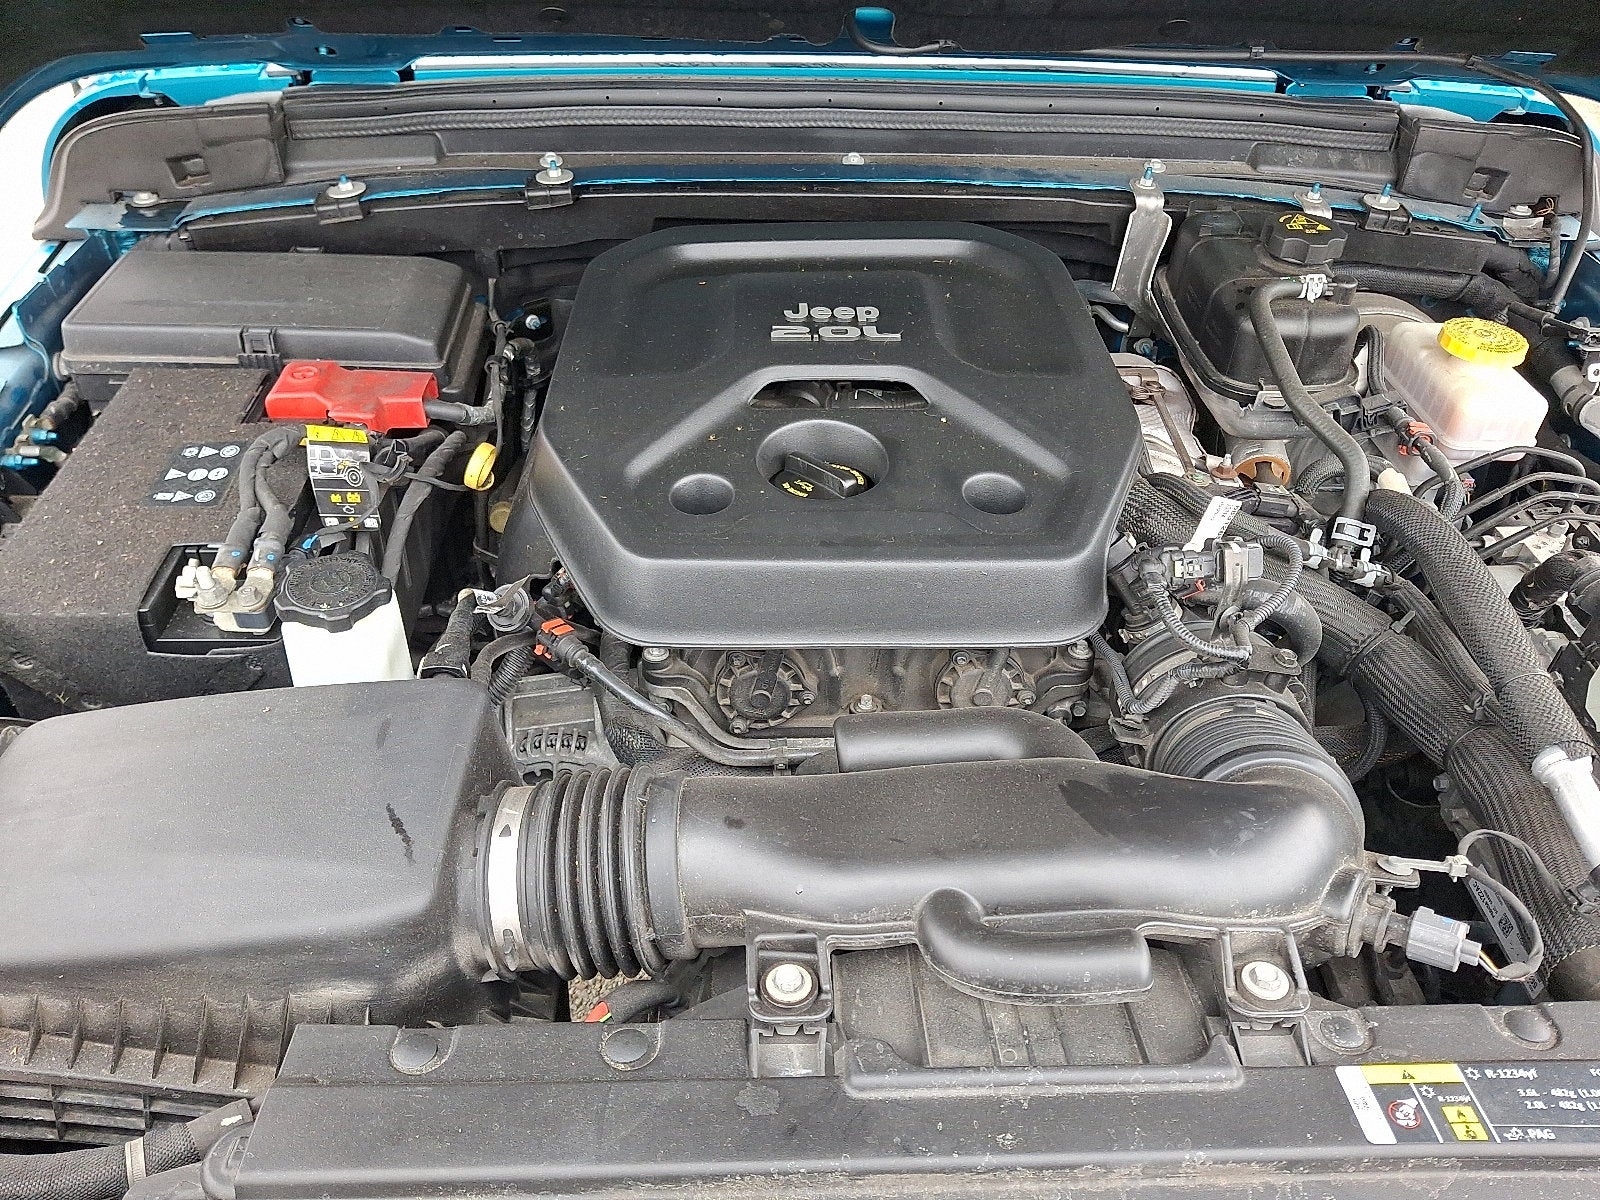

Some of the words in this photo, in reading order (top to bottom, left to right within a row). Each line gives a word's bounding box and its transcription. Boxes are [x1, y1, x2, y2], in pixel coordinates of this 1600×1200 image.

[783, 302, 880, 323] Jeep
[770, 325, 903, 342] 2.0L
[1485, 1067, 1538, 1081] R-1234yf
[1516, 1088, 1541, 1097] 3.6L
[1524, 1100, 1549, 1110] 2.0L
[1526, 1128, 1557, 1140] PAG
